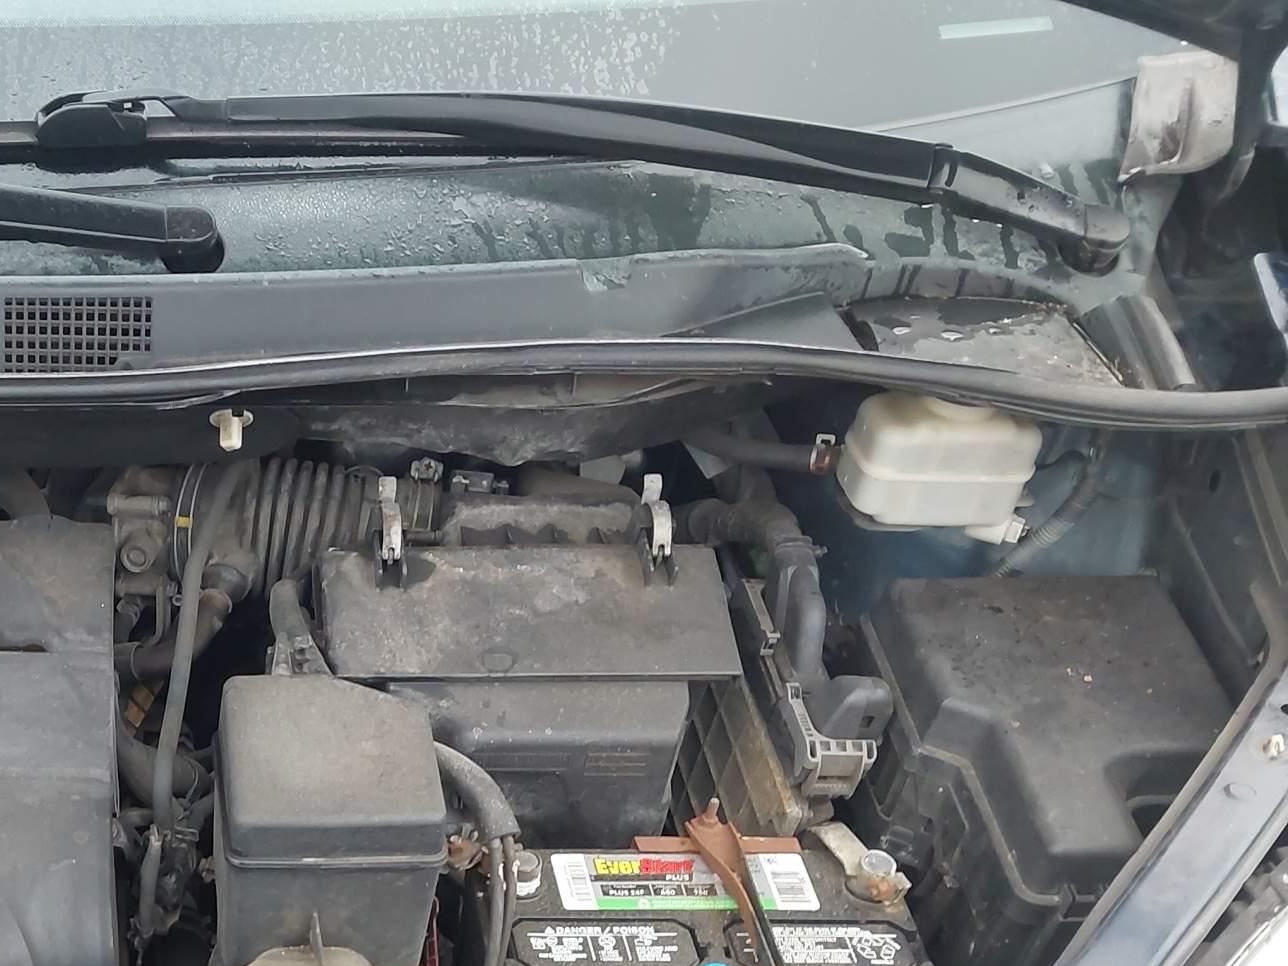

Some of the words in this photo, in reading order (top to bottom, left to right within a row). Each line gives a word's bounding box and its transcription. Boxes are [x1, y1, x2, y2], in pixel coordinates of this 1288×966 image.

[594, 858, 694, 875] EverStart
[665, 873, 689, 882] PLUS
[555, 926, 602, 935] DANGER
[612, 926, 655, 936] POISON
